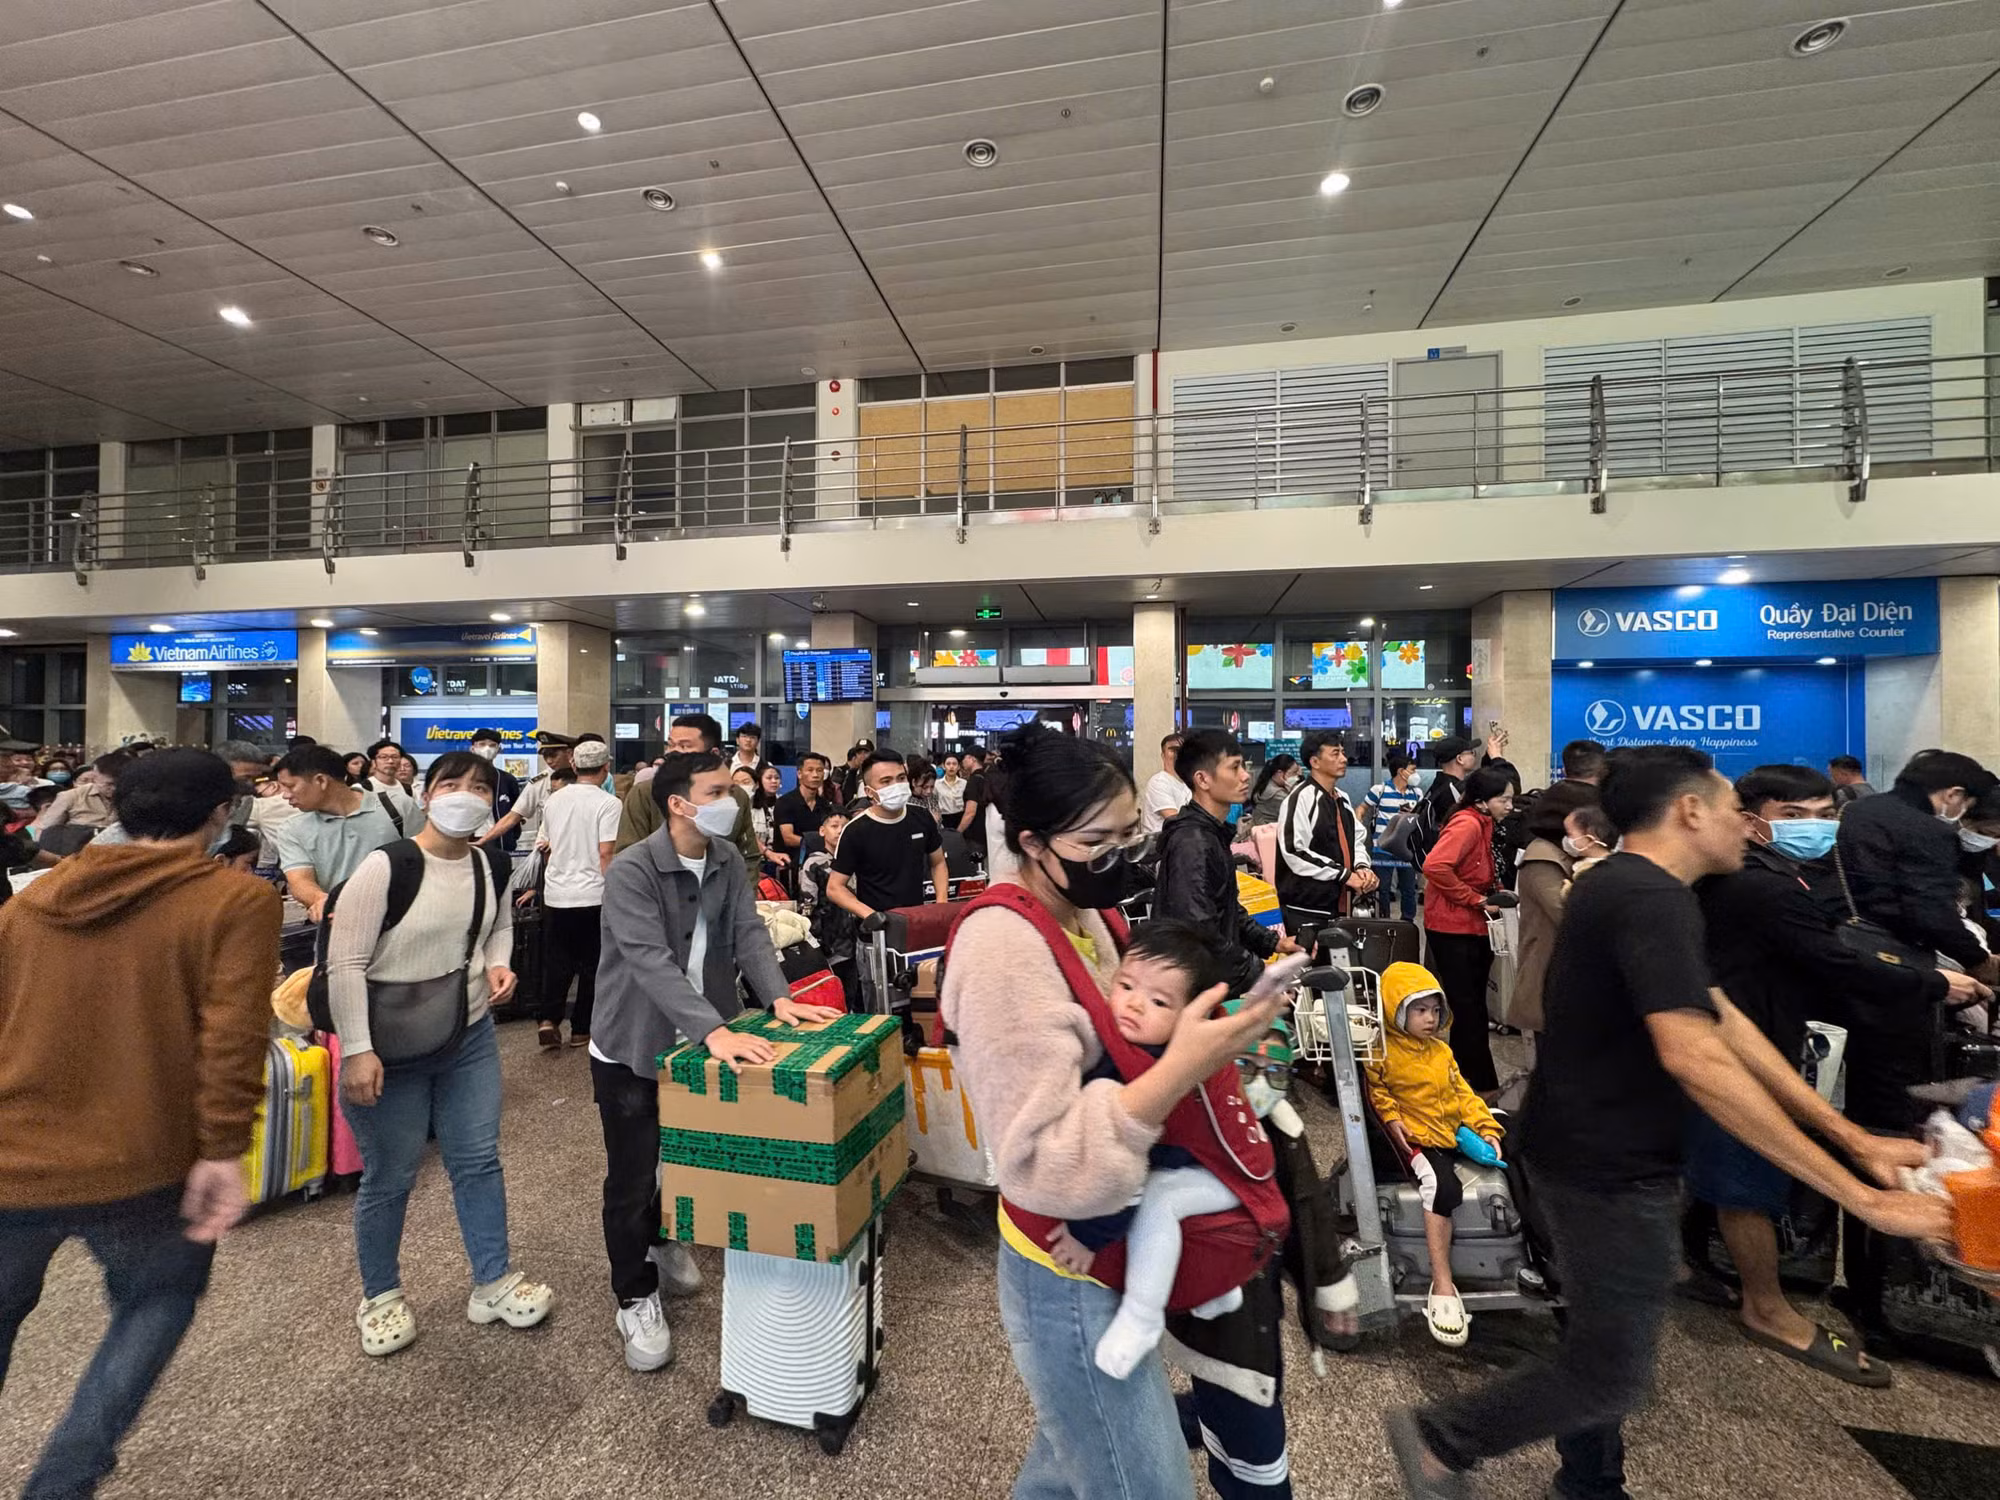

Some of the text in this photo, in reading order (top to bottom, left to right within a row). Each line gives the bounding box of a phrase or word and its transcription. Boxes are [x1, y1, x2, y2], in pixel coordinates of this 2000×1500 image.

[1615, 609, 1719, 632] VASCO
[1759, 601, 1913, 629] Quầy Đại Diện
[1767, 626, 1906, 642] Representative Counter
[154, 644, 259, 661] Vietnam Airlines
[1631, 704, 1761, 731] VASCO
[1700, 737, 1758, 750] Happiness
